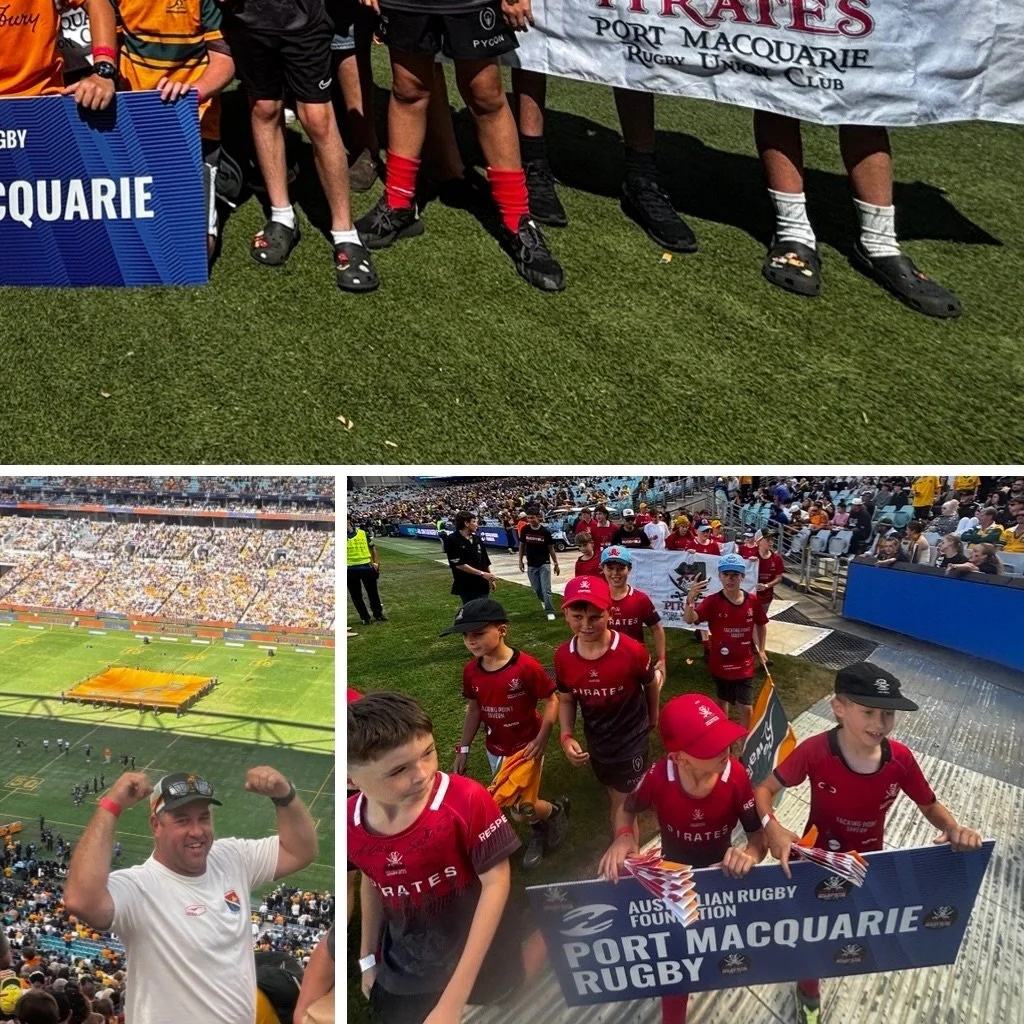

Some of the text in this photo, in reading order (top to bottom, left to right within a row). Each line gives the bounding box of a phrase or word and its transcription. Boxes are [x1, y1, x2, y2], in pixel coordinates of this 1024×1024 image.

[588, 16, 874, 72] PORT MACQUARIE
[737, 885, 798, 904] RUGBY
[563, 905, 924, 969] PORT MACQUARIE
[572, 956, 705, 996] RUGBY
